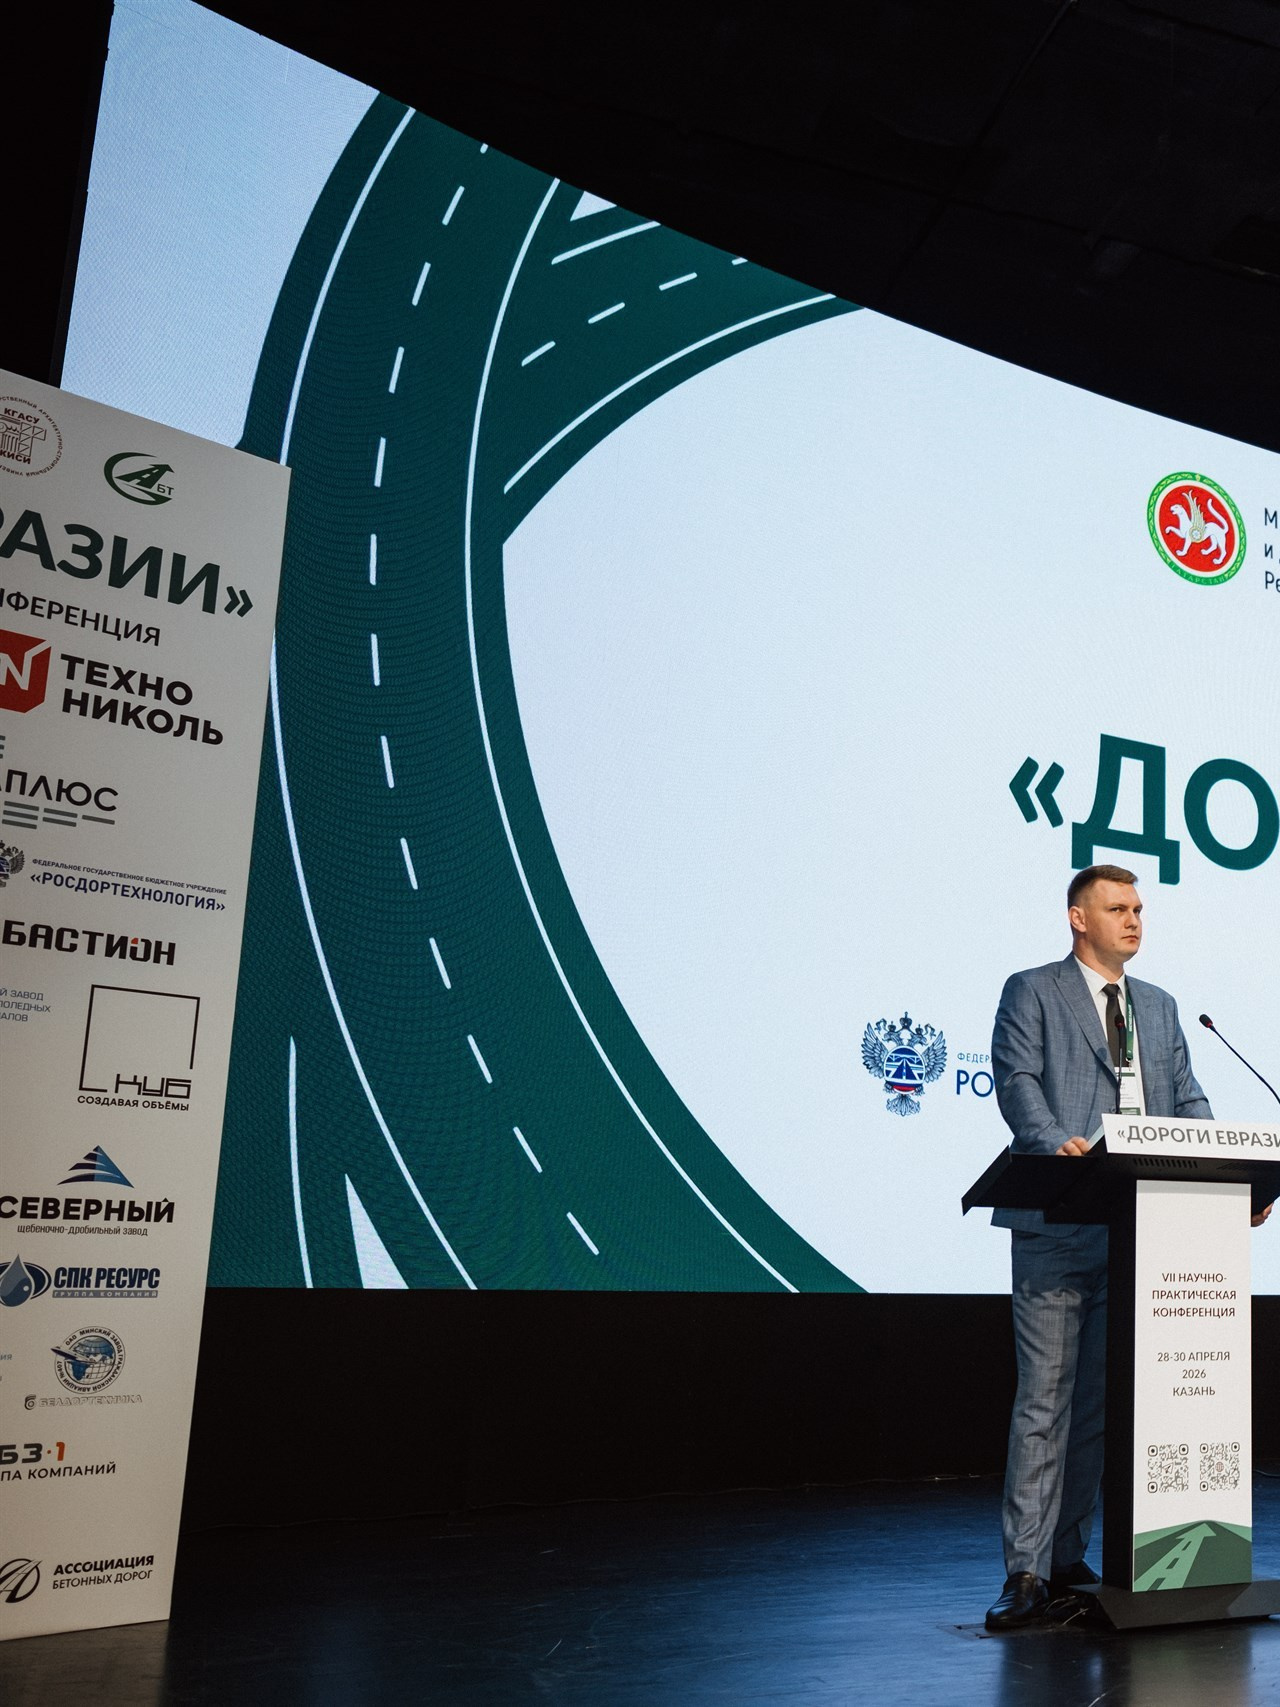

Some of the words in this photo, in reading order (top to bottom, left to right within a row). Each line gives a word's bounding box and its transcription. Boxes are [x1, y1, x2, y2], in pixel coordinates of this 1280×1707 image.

[4, 407, 40, 424] КГАСУ
[0, 449, 32, 465] КИСИ
[1264, 543, 1274, 559] и
[0, 507, 254, 618] АЗИИ»
[60, 653, 194, 706] ТЕХНО
[62, 688, 224, 746] НИКОЛЬ
[0, 769, 119, 812] ПЛЮС
[32, 858, 82, 872] ФЕДЕРАЛЬНОЕ
[83, 866, 144, 882] ГОСУДАРСТВЕННОЕ
[145, 876, 185, 889] БЮДЖЕТНОЕ
[185, 882, 227, 895] УЧРЕЖДЕНИЕ
[30, 872, 226, 911] «РОСДОРТЕХНОЛОГИЯ»
[2, 919, 176, 966] БАСТИОН
[10, 989, 44, 1001] ЗАВОД
[0, 1012, 28, 1022] АЛОВ
[957, 1052, 992, 1064] ФЕДЕР
[956, 1069, 994, 1098] РО
[77, 1095, 139, 1108] СОЗДАВАЯ
[142, 1100, 190, 1112] ОБЪЁМЫ
[1117, 1125, 1211, 1145] «ДОРОГИ
[0, 1195, 175, 1224] СЕВЕРНЫЙ
[17, 1224, 121, 1235] щебеночно-дробильный
[122, 1227, 149, 1236] завод
[54, 1266, 93, 1289] СПК
[95, 1267, 161, 1289] РЕСУРС
[1162, 1273, 1176, 1282] VII
[1178, 1273, 1228, 1283] НАУЧНО-
[1152, 1290, 1237, 1300] ПРАКТИЧЕСКАЯ
[1153, 1307, 1235, 1319] КОНФЕРЕНЦИЯ
[1157, 1351, 1186, 1362] 28-30
[1188, 1351, 1231, 1361] АПРЕЛЯ
[1182, 1368, 1206, 1379] 2026
[1172, 1386, 1216, 1397] КАЗАНЬ
[28, 1461, 117, 1480] КОМПАНИЙ
[53, 1555, 155, 1576] АССОЦИАЦИЯ
[52, 1573, 112, 1590] БЕТОННЫХ
[114, 1569, 153, 1585] ДОРОГ
